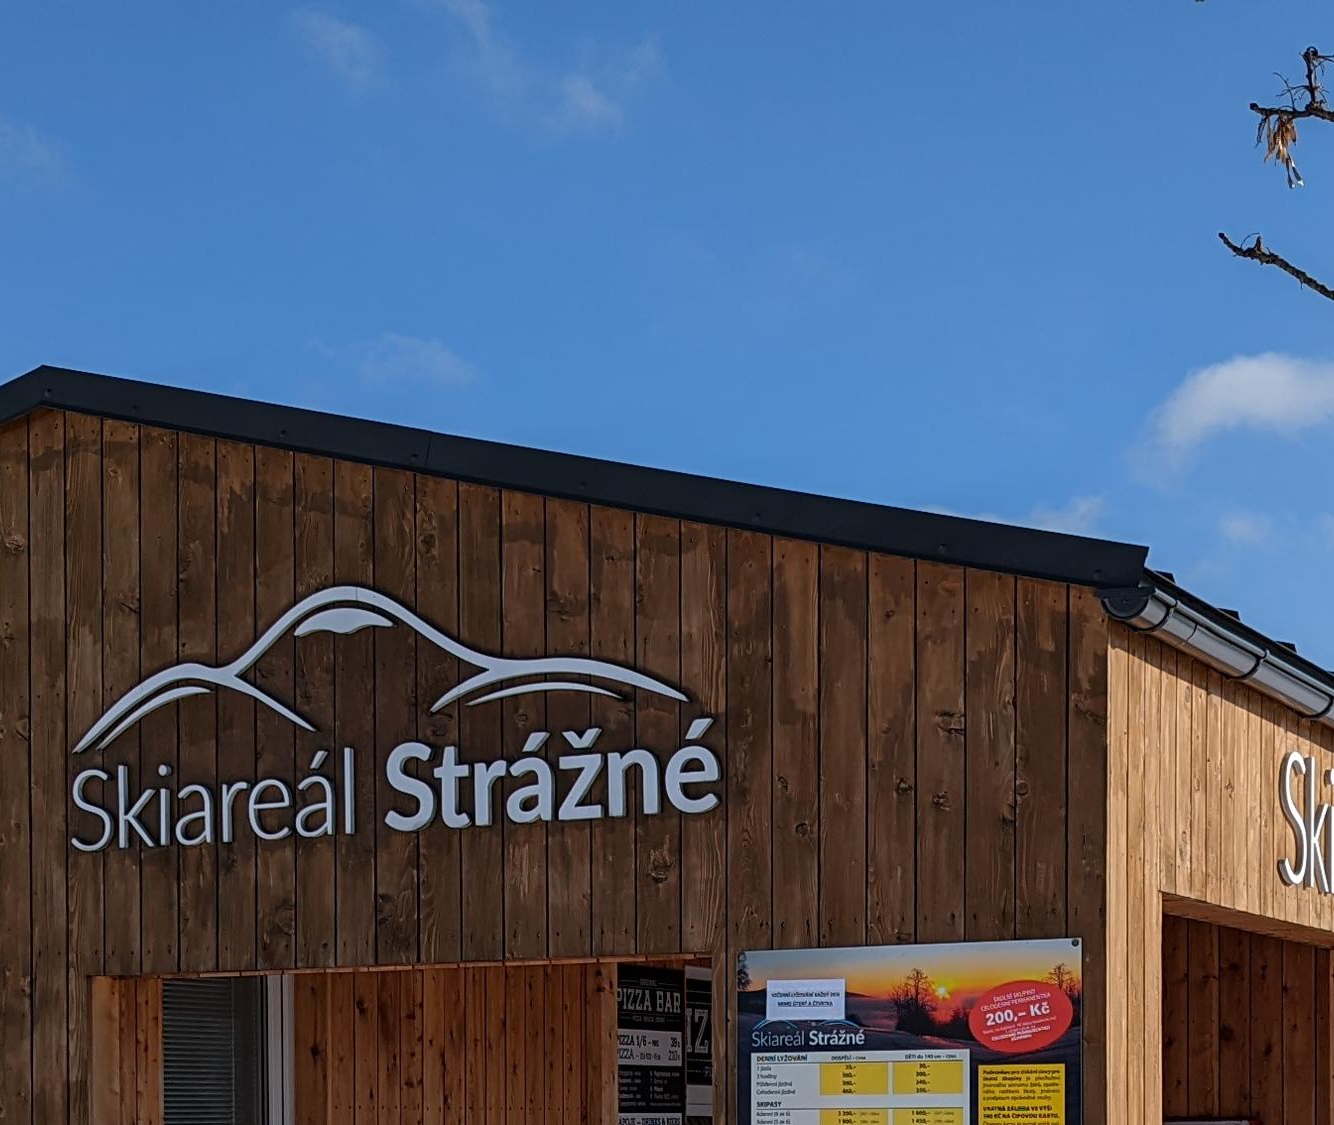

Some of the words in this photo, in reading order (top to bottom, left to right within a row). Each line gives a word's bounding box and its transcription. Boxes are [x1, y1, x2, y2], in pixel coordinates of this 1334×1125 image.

[70, 747, 356, 852] Skiareál
[383, 717, 720, 831] Strážné
[656, 991, 681, 1014] BAR
[1030, 1002, 1050, 1016] Kč
[618, 1035, 635, 1046] IZZA
[751, 1031, 804, 1047] Skiareál
[809, 1029, 865, 1045] Strážné
